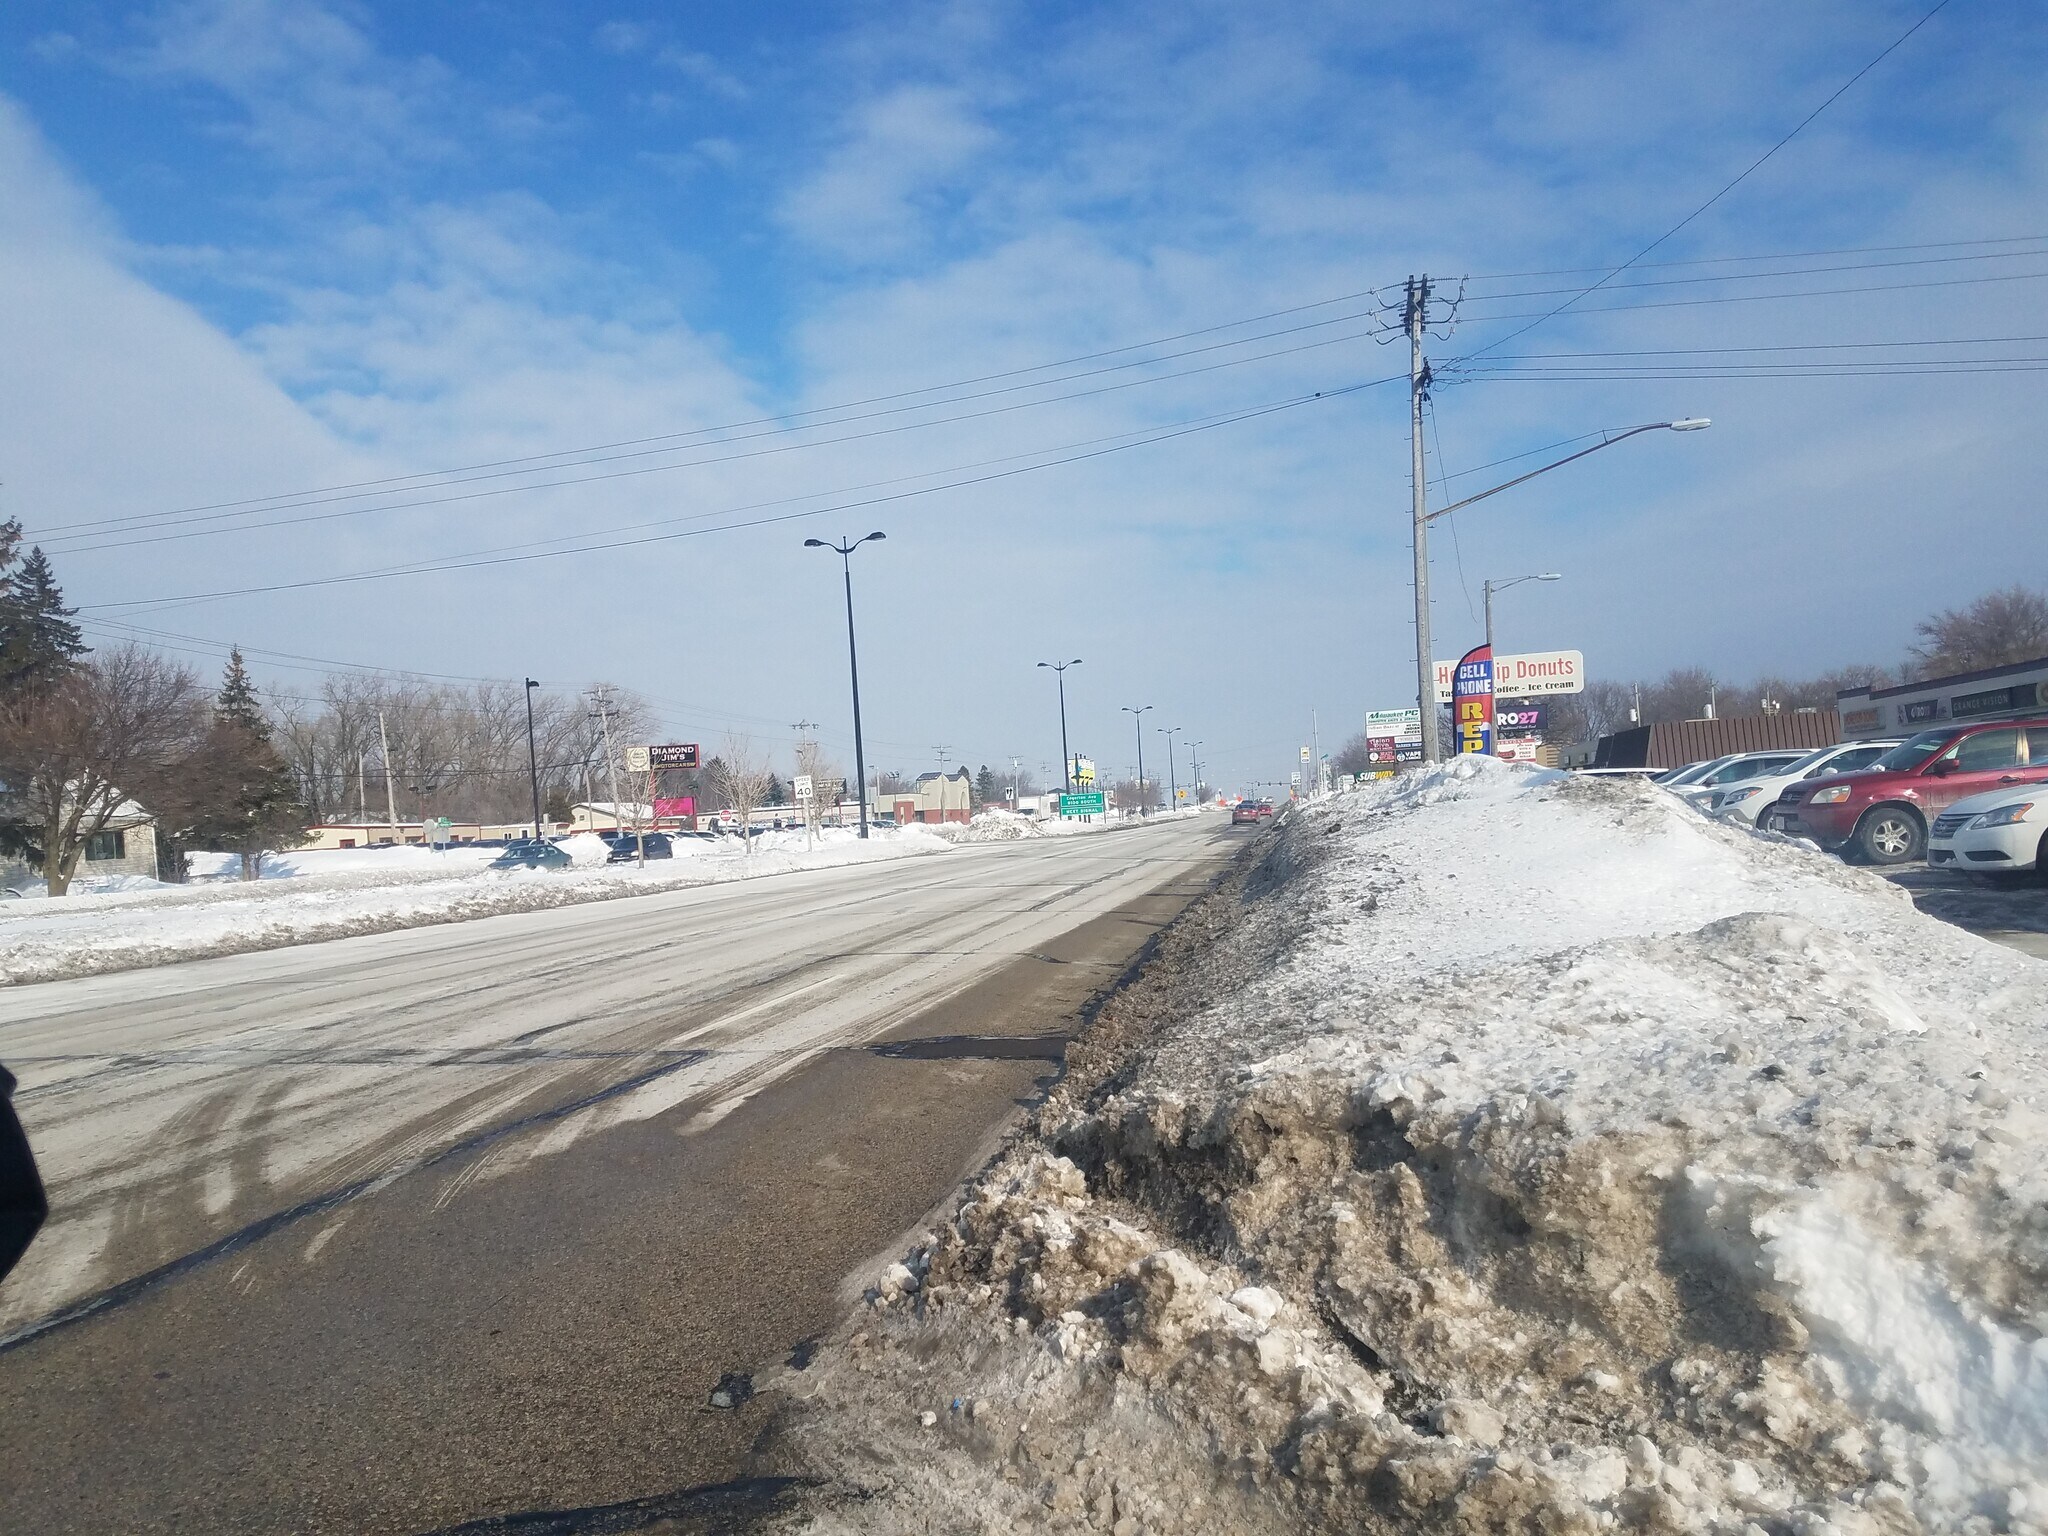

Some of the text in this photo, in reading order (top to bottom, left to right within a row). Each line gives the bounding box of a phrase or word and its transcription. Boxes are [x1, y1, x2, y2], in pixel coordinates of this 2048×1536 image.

[1460, 663, 1488, 679] CELL
[1516, 658, 1574, 678] Donuts
[1528, 683, 1542, 691] Ice
[1545, 681, 1574, 689] Cream
[1496, 711, 1539, 726] RO27
[651, 746, 695, 755] DIAMOND
[661, 753, 686, 761] JIM'S
[1358, 770, 1395, 781] SUBWAY
[797, 787, 811, 796] 40
